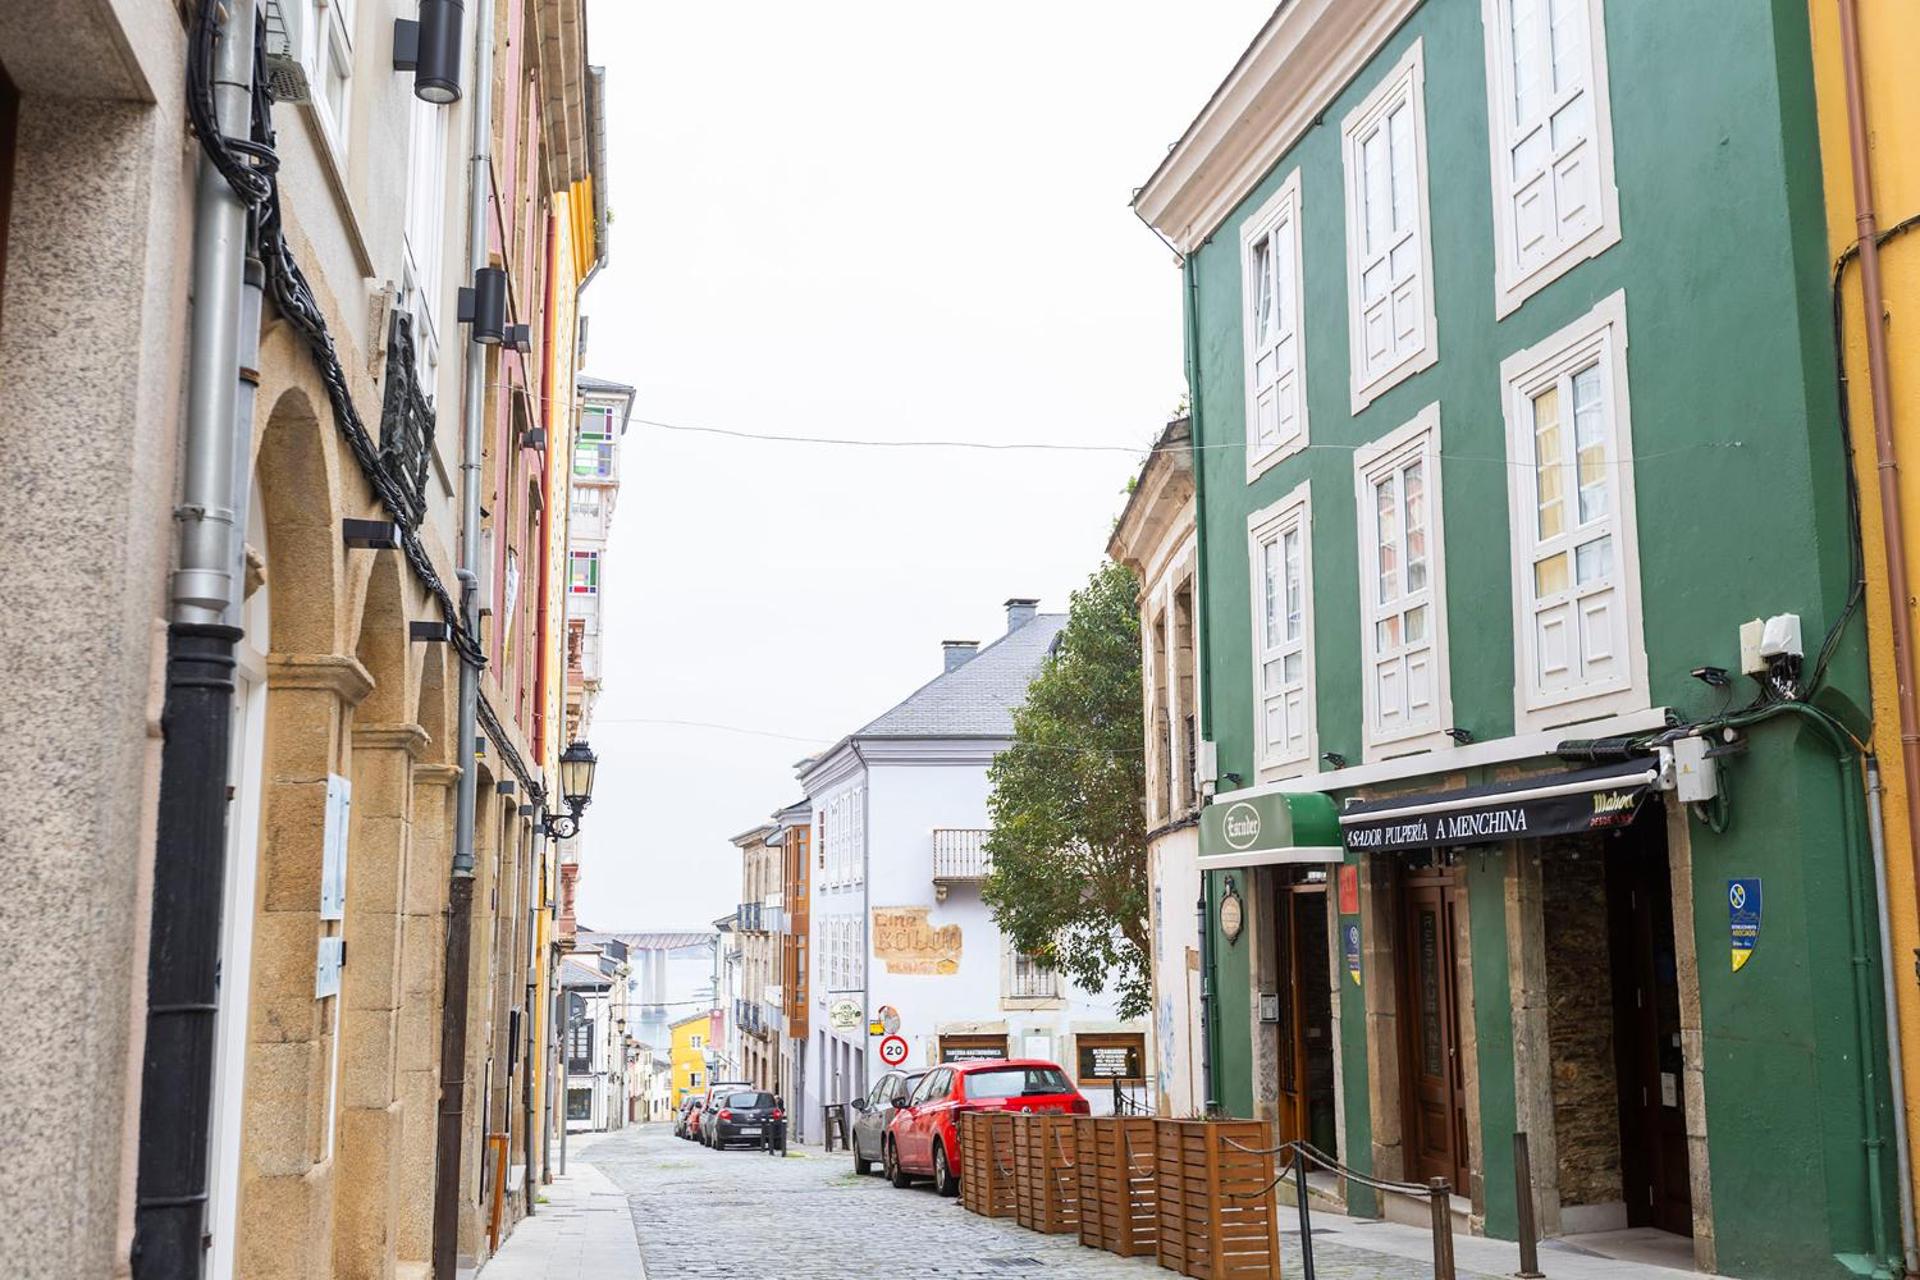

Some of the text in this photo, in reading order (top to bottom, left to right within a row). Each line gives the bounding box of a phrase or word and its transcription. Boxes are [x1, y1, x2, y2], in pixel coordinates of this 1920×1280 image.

[1385, 818, 1429, 845] PULPERÍA
[1435, 818, 1446, 840] A
[1449, 808, 1528, 838] MENCHINA
[886, 1046, 903, 1056] 20
